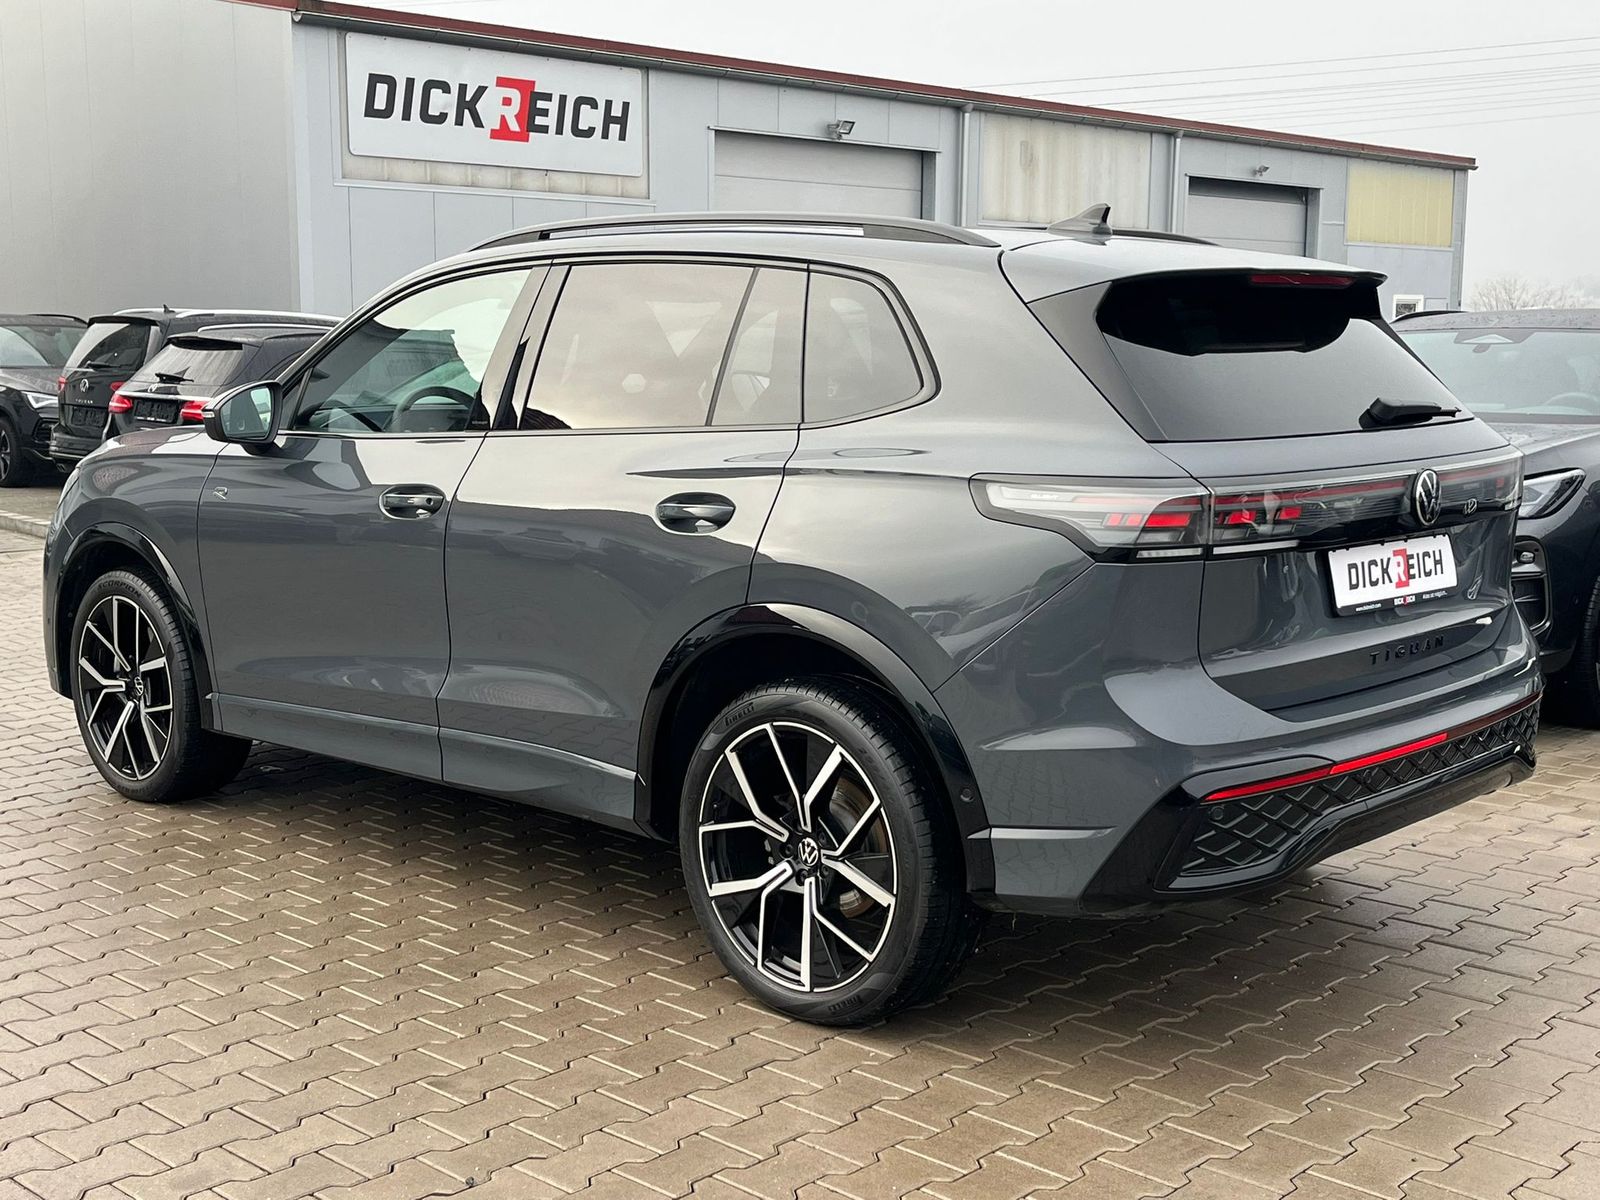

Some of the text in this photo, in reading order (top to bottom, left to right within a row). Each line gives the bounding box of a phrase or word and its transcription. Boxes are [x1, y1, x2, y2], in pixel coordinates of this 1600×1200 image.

[364, 73, 630, 142] DICKREICH
[1347, 548, 1444, 590] DICKREICH
[1370, 635, 1444, 665] TIGUAN
